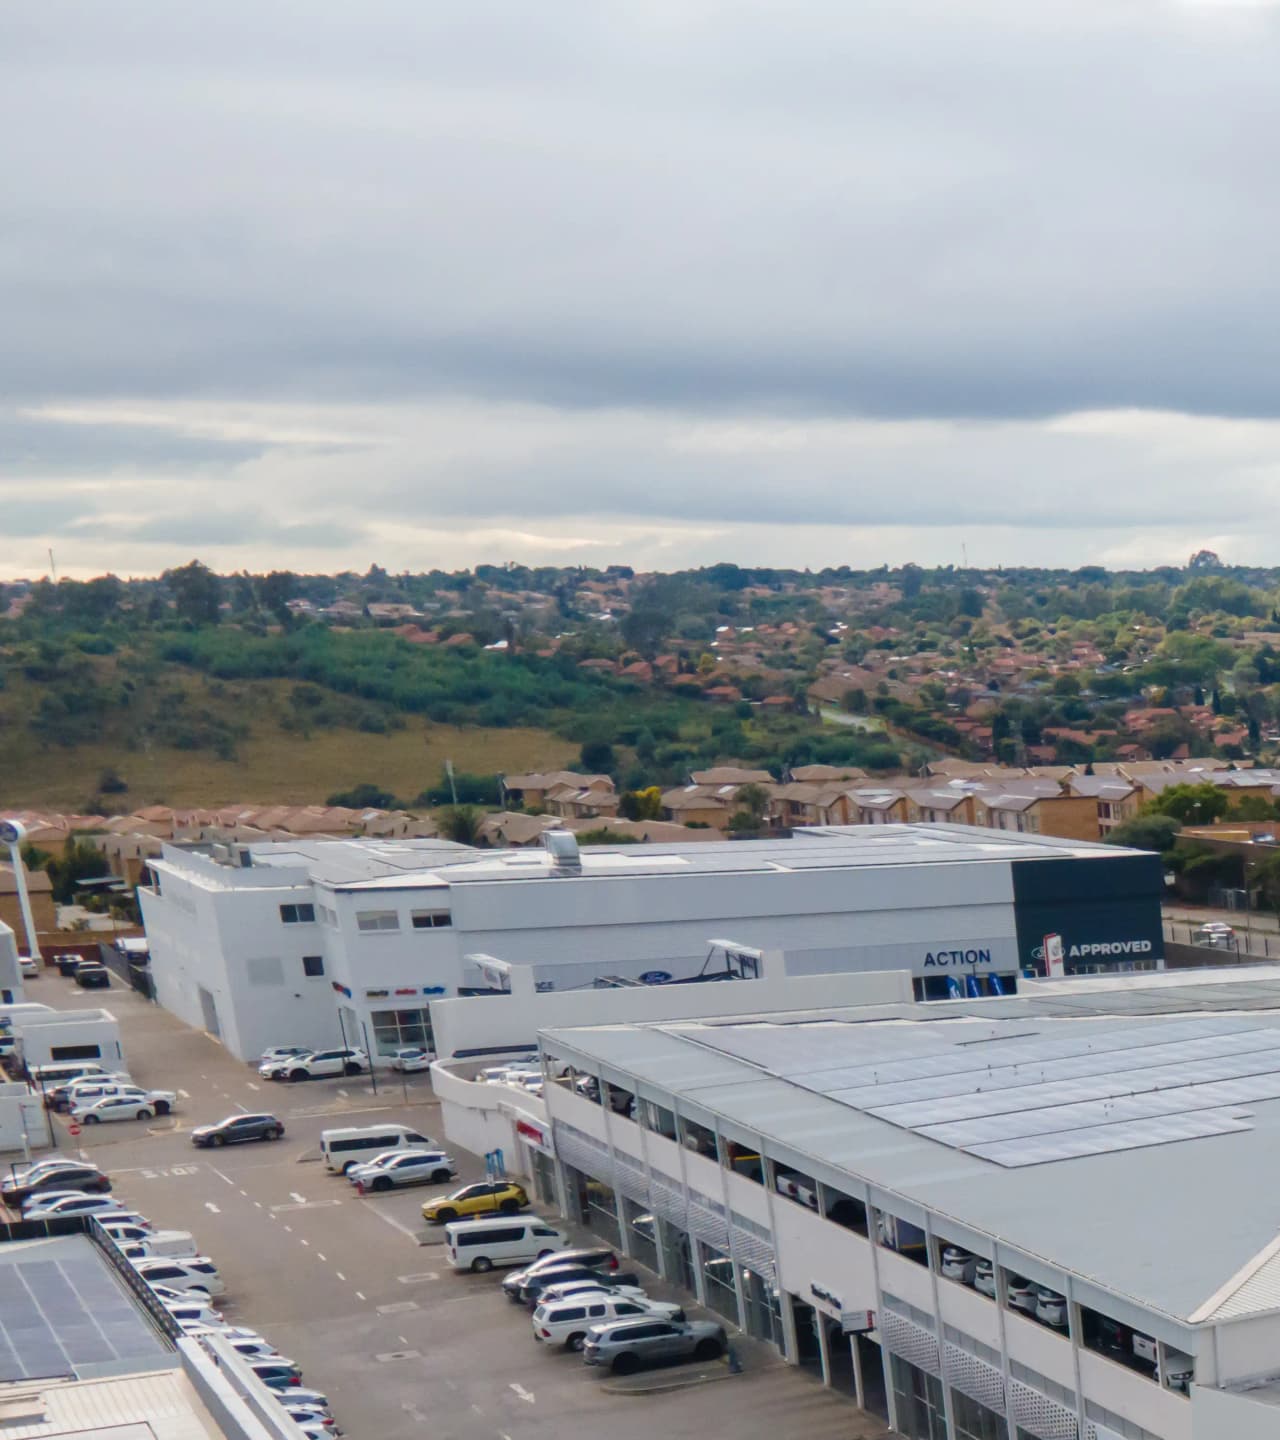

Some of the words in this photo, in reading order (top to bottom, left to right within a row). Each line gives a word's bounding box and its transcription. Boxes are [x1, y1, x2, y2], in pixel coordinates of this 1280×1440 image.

[1069, 940, 1152, 957] APPROVED
[923, 949, 991, 967] ACTION
[141, 1166, 199, 1178] STOP
